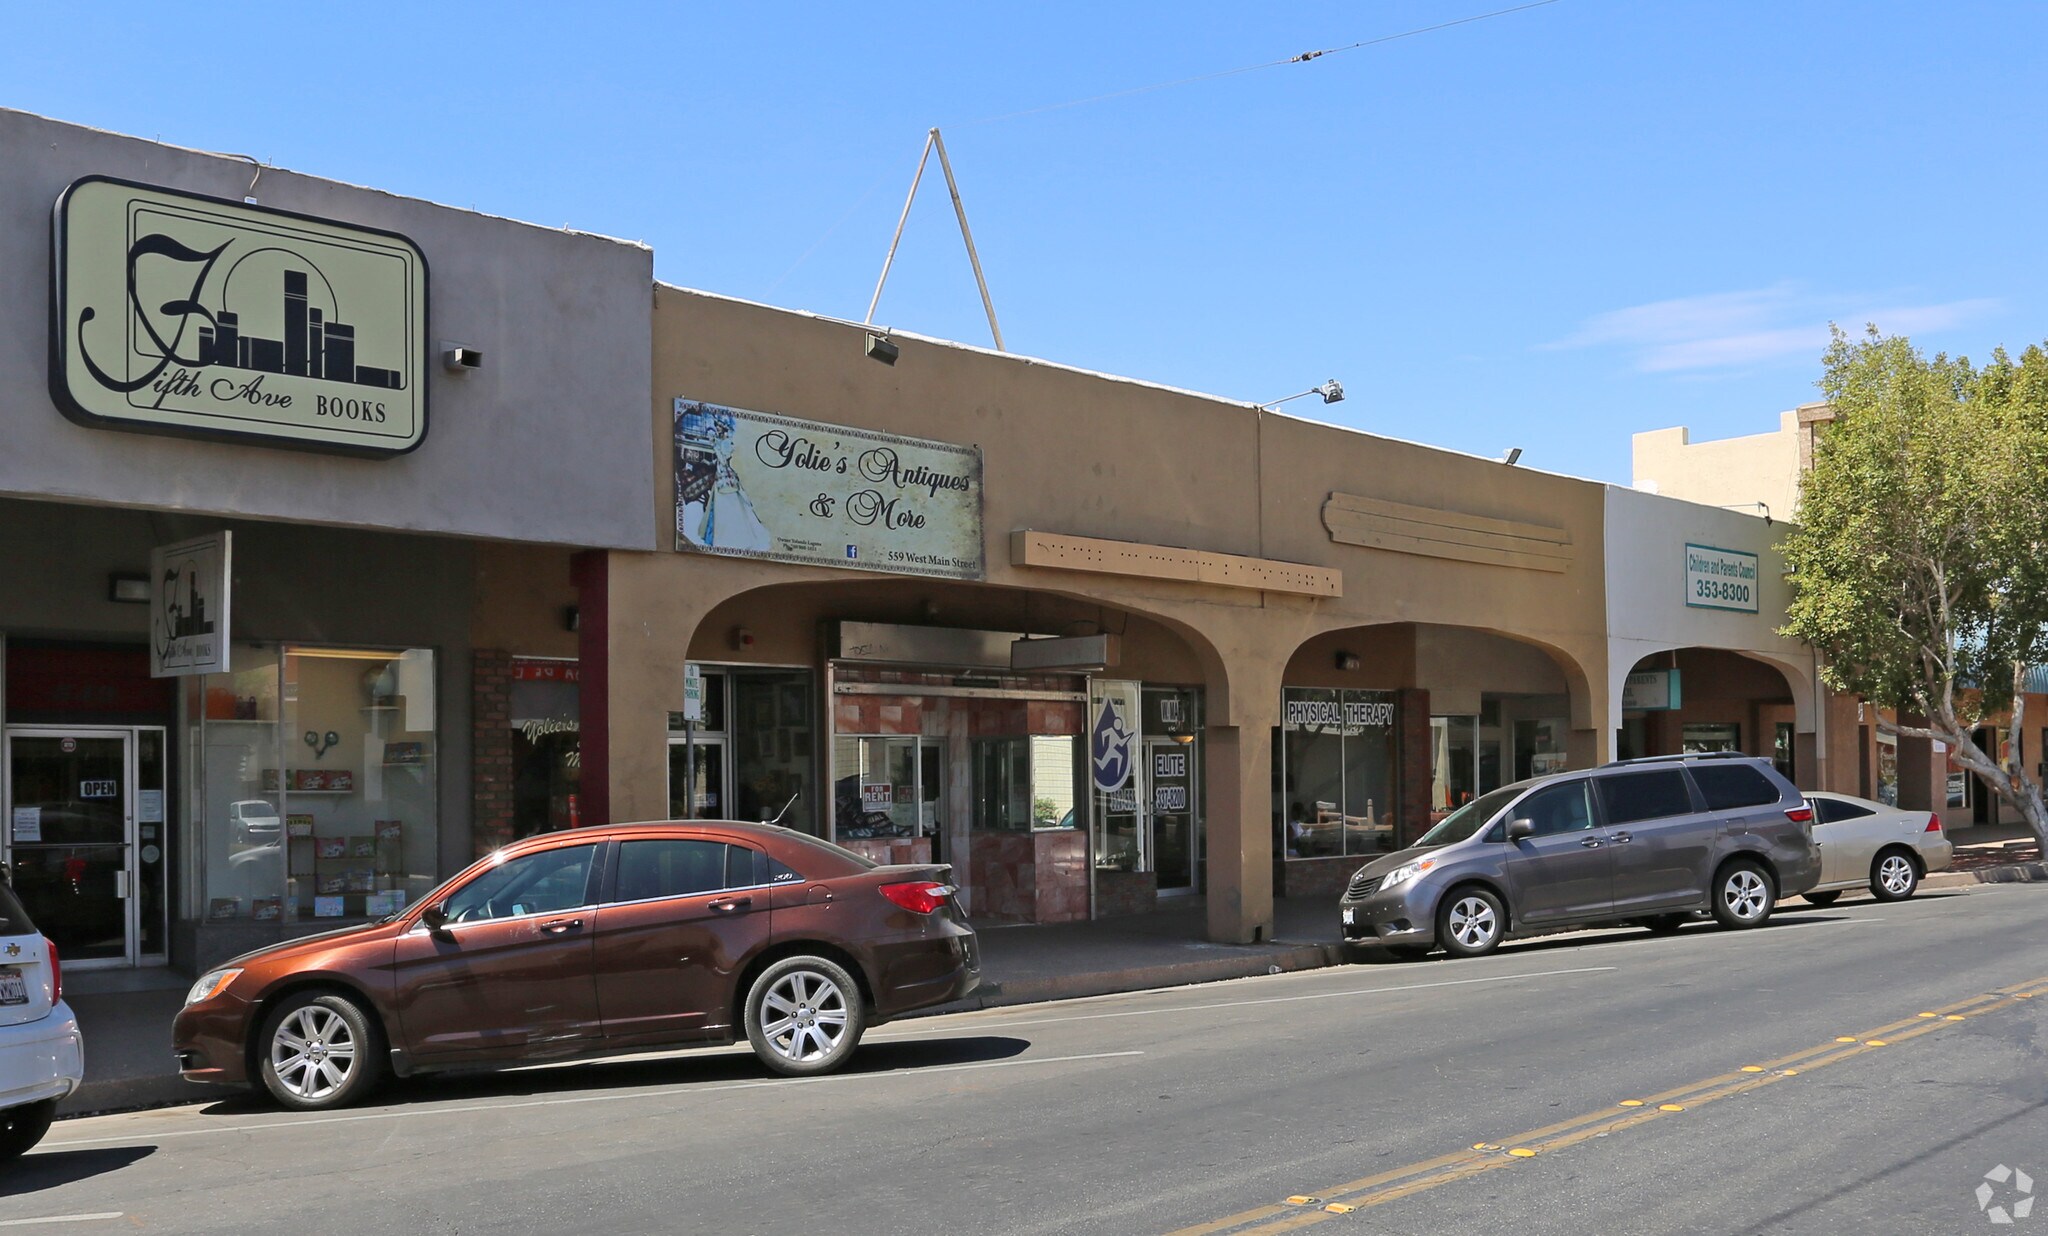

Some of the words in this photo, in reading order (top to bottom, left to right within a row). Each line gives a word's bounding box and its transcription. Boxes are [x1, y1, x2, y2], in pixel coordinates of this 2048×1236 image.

[210, 375, 293, 409] Ave
[316, 395, 387, 423] BOOKS
[755, 429, 847, 474] Yolie's
[858, 446, 971, 498] Antiques
[809, 493, 835, 518] &
[846, 489, 926, 531] More
[888, 551, 904, 562] 559
[906, 552, 928, 564] West
[928, 554, 950, 566] Main
[951, 556, 976, 569] Street
[1689, 553, 1710, 573] Children
[1711, 557, 1720, 575] and
[1720, 558, 1738, 578] Parents
[1739, 561, 1756, 580] Council
[1287, 700, 1341, 724] PHYSICAL
[1344, 702, 1394, 725] THERAPY
[1155, 753, 1185, 777] ELITE
[84, 781, 115, 796] OPEN
[864, 792, 890, 802] RENT
